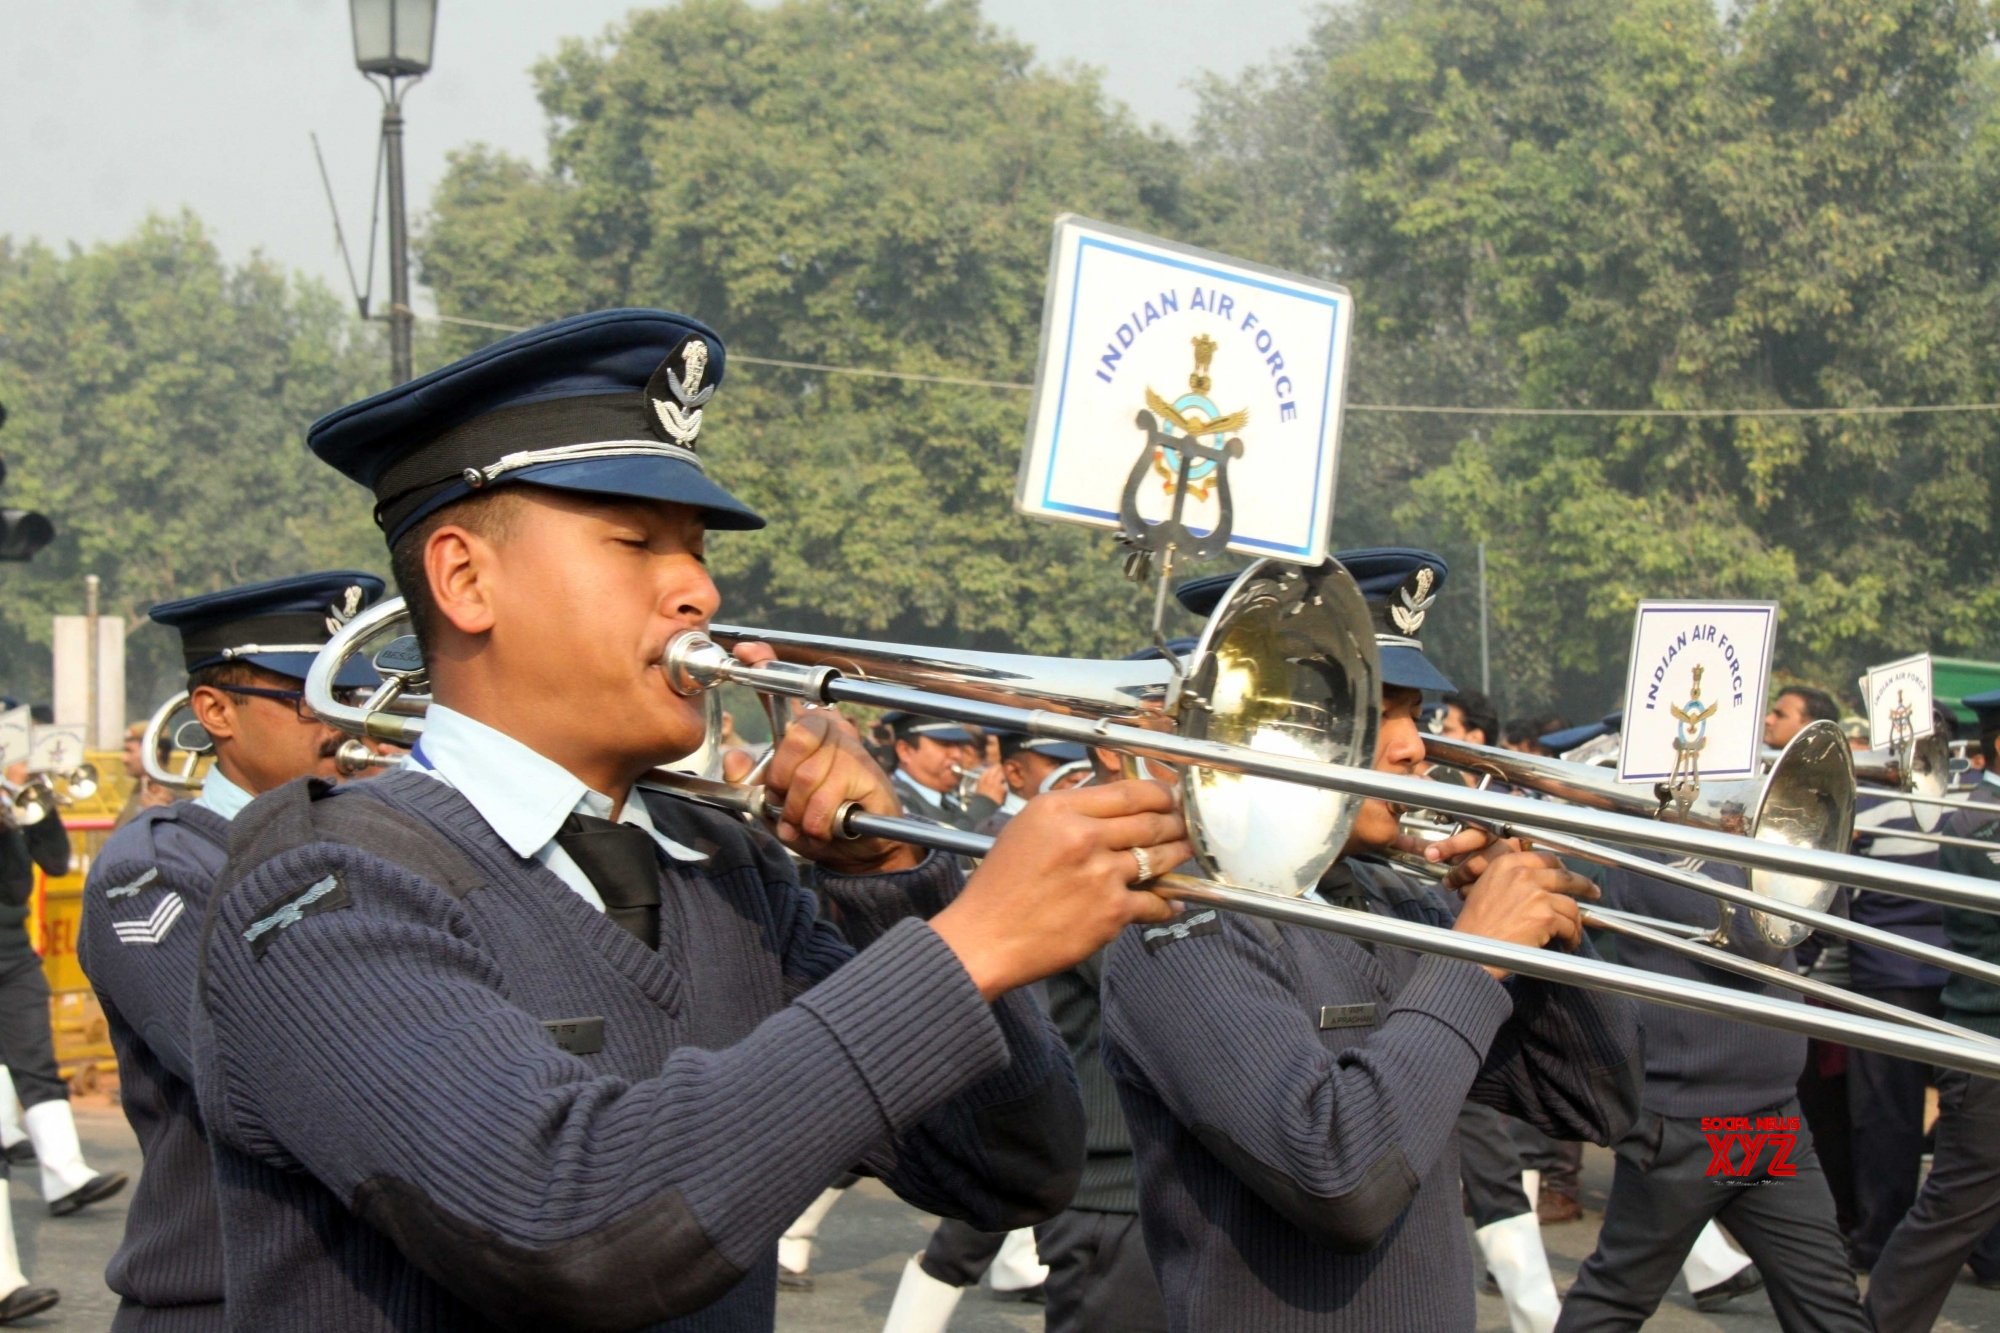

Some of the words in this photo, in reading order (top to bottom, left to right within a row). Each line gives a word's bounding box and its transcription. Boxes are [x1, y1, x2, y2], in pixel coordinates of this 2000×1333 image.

[1095, 288, 1180, 384] INDIAN
[1189, 286, 1236, 321] AIR
[1240, 311, 1298, 424] FORCE
[1645, 631, 1687, 710] INDIAN
[1691, 624, 1717, 643] AIR
[1718, 633, 1743, 708] FORCE
[1895, 672, 1905, 680] AIR
